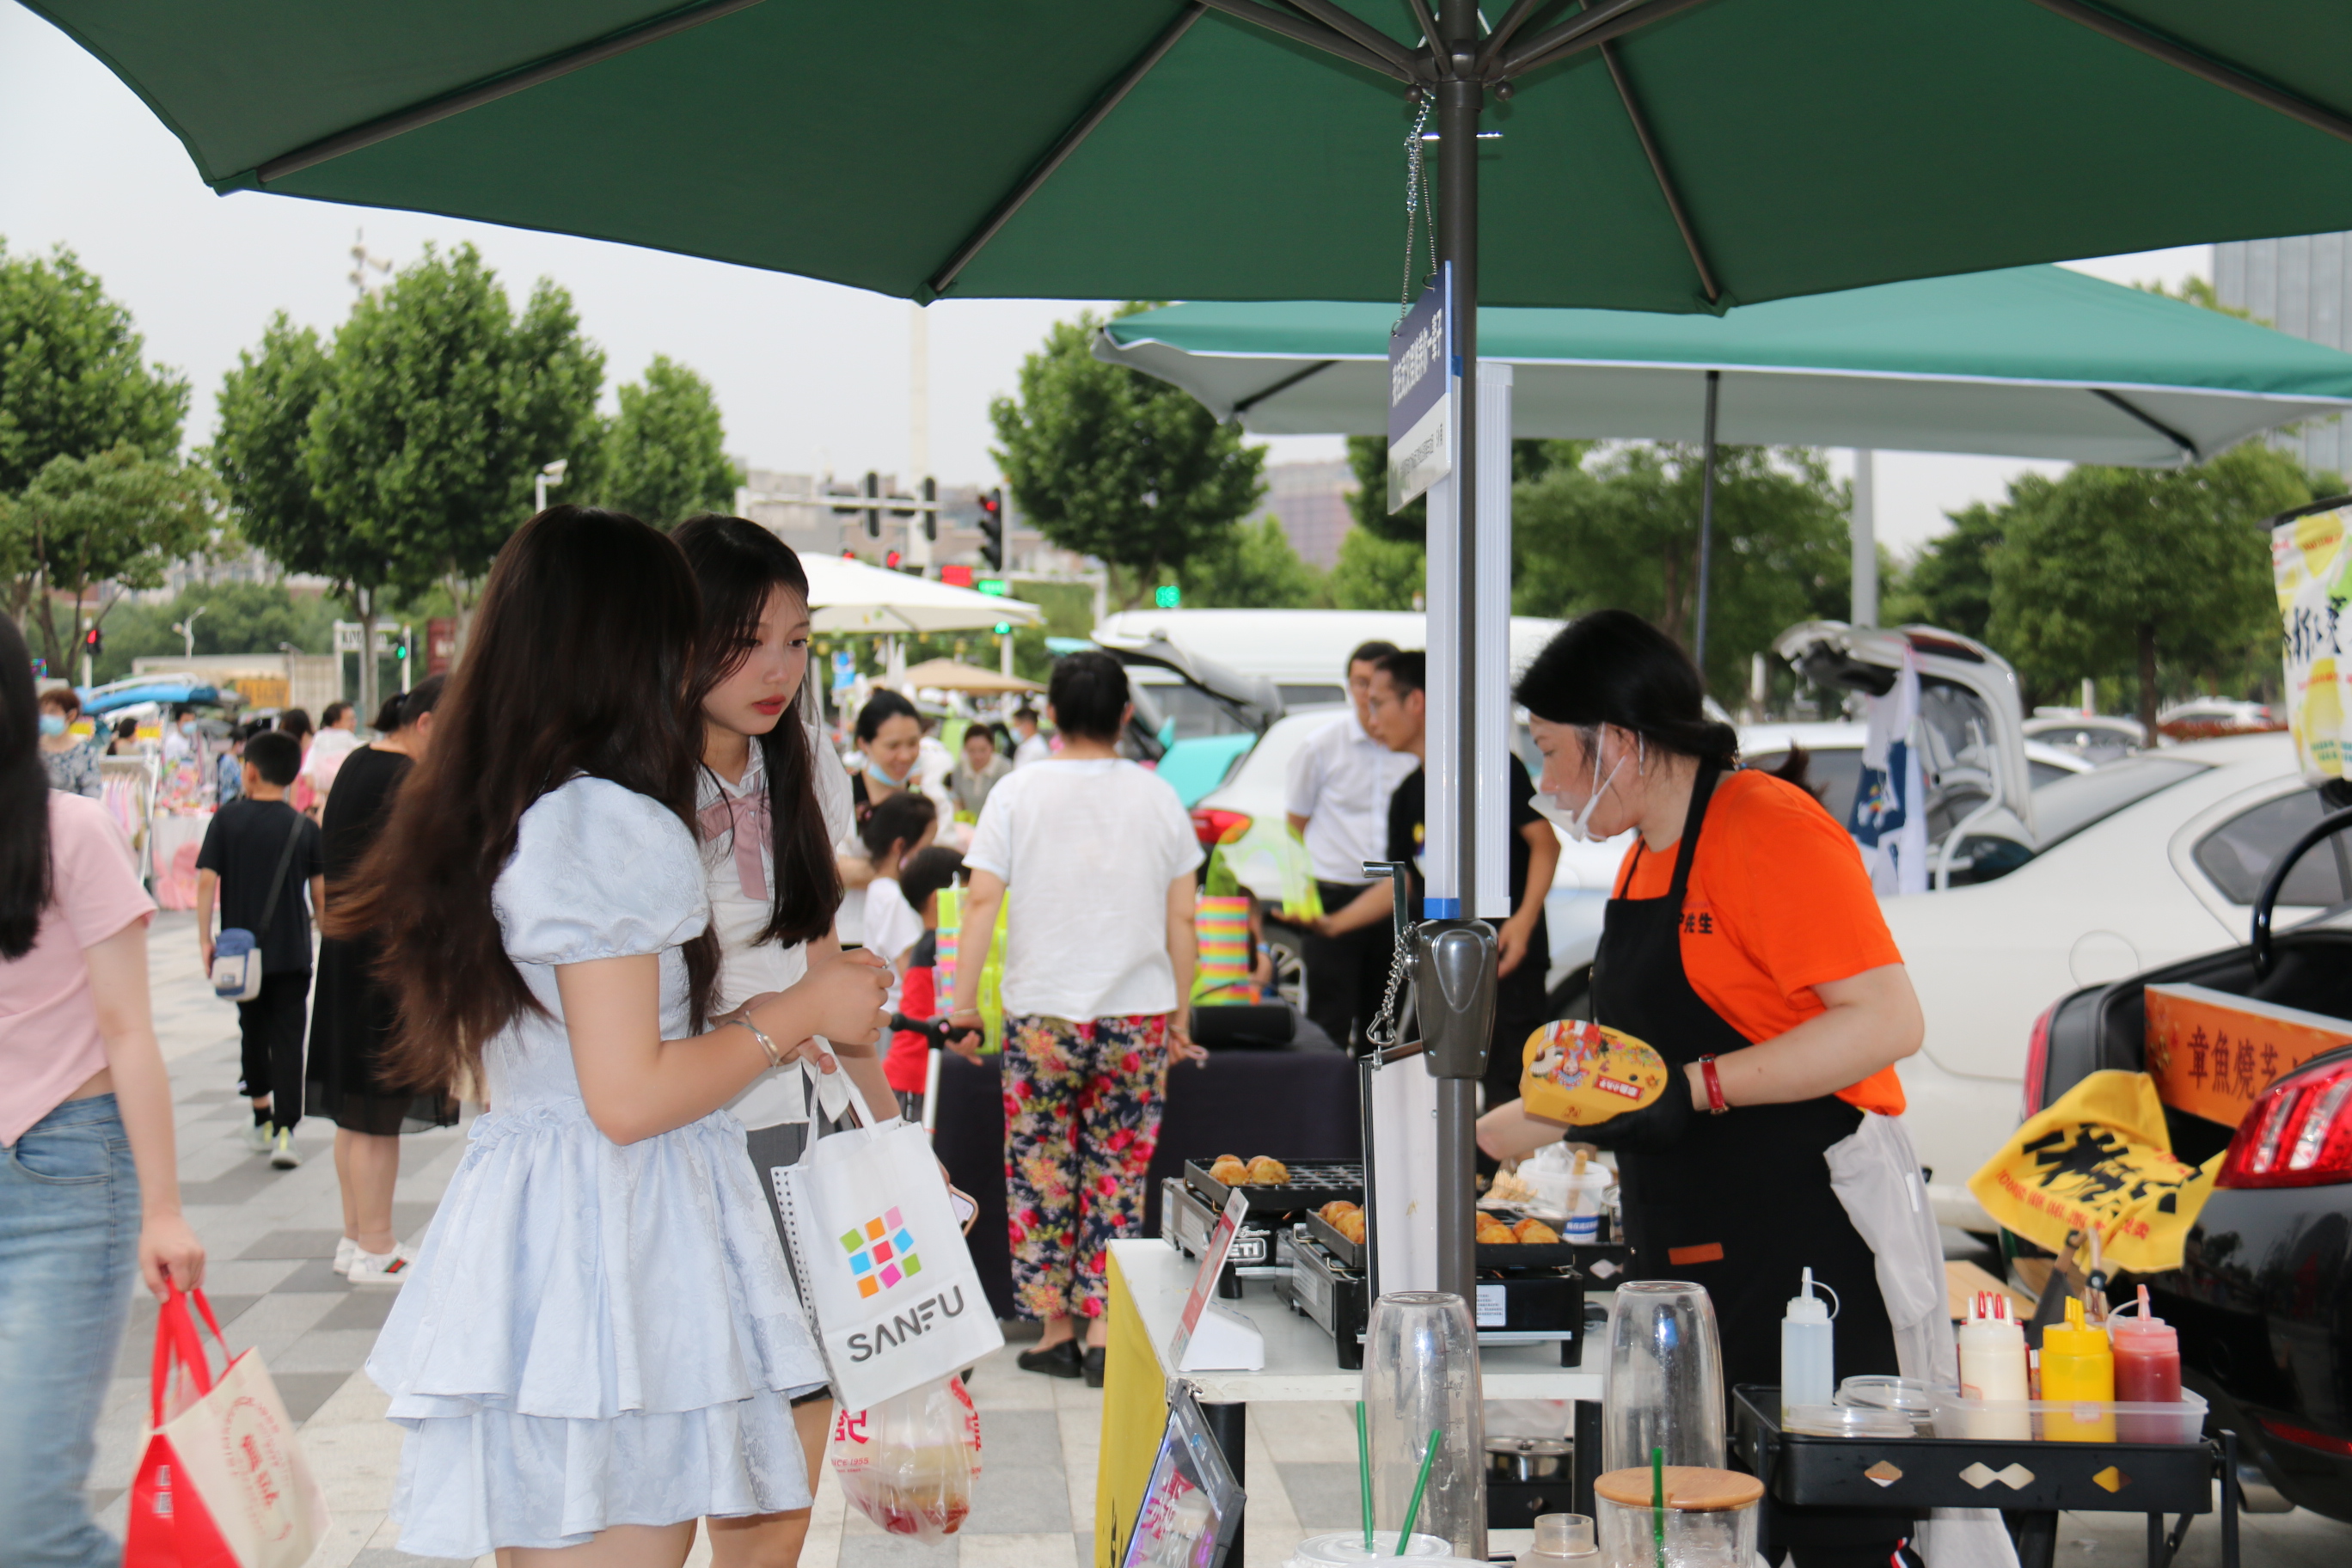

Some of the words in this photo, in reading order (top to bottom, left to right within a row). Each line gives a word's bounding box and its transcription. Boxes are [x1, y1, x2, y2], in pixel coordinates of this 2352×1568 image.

[1679, 912, 1712, 934] 先生
[2187, 1024, 2299, 1101] 章魚燒芝
[1229, 1242, 1259, 1257] ETI
[847, 1285, 964, 1363] SANFU
[850, 1457, 869, 1466] 1955
